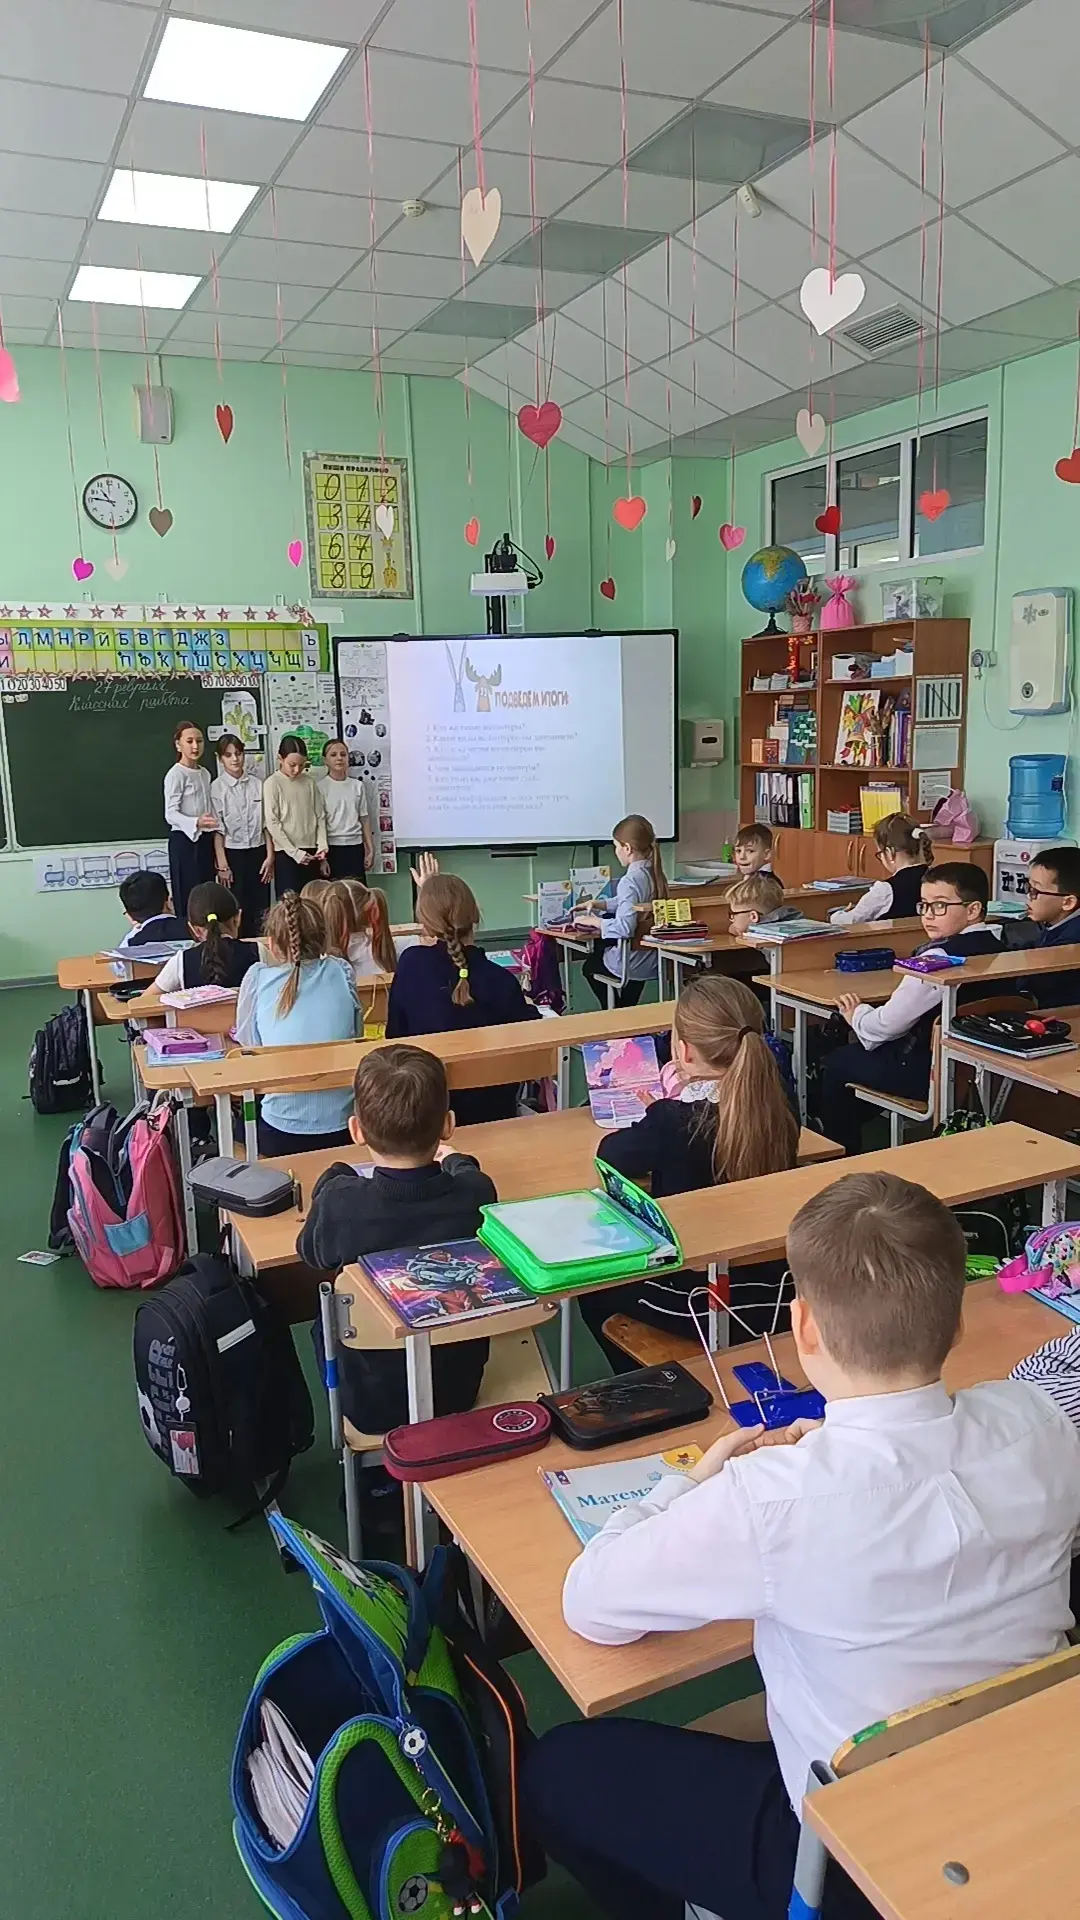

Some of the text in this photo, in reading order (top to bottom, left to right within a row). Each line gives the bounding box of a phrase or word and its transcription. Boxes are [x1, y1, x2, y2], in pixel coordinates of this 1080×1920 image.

[324, 474, 398, 503] 0 1 2
[327, 504, 342, 530] 3
[356, 504, 371, 530] 4
[328, 532, 371, 560] 6 7
[330, 562, 374, 589] 8 9
[18, 632, 29, 646] Л
[38, 632, 50, 646] М
[59, 632, 70, 646] Н
[79, 632, 90, 646] Р
[96, 631, 110, 647] Й
[120, 632, 130, 646] Б
[139, 633, 150, 646] В
[158, 632, 167, 646] Г
[177, 632, 188, 646] Д
[194, 632, 209, 646] Ж
[216, 632, 225, 646] З
[304, 634, 316, 646] Ъ
[120, 654, 132, 668] П
[140, 654, 152, 668] Ф
[160, 654, 170, 668] К
[178, 654, 189, 668] Т
[197, 655, 210, 668] Ш
[216, 654, 227, 668] С
[235, 654, 246, 667] Х
[253, 654, 264, 668] Ц
[271, 654, 282, 668] Ч
[288, 654, 301, 668] Щ
[307, 654, 316, 668] Ь
[1, 679, 66, 691] 10 20 30 40 50
[94, 680, 112, 694] 27
[203, 676, 214, 688] 60
[215, 676, 225, 688] 70
[226, 676, 236, 688] 80
[236, 676, 248, 688] 90
[68, 695, 130, 712] Классная
